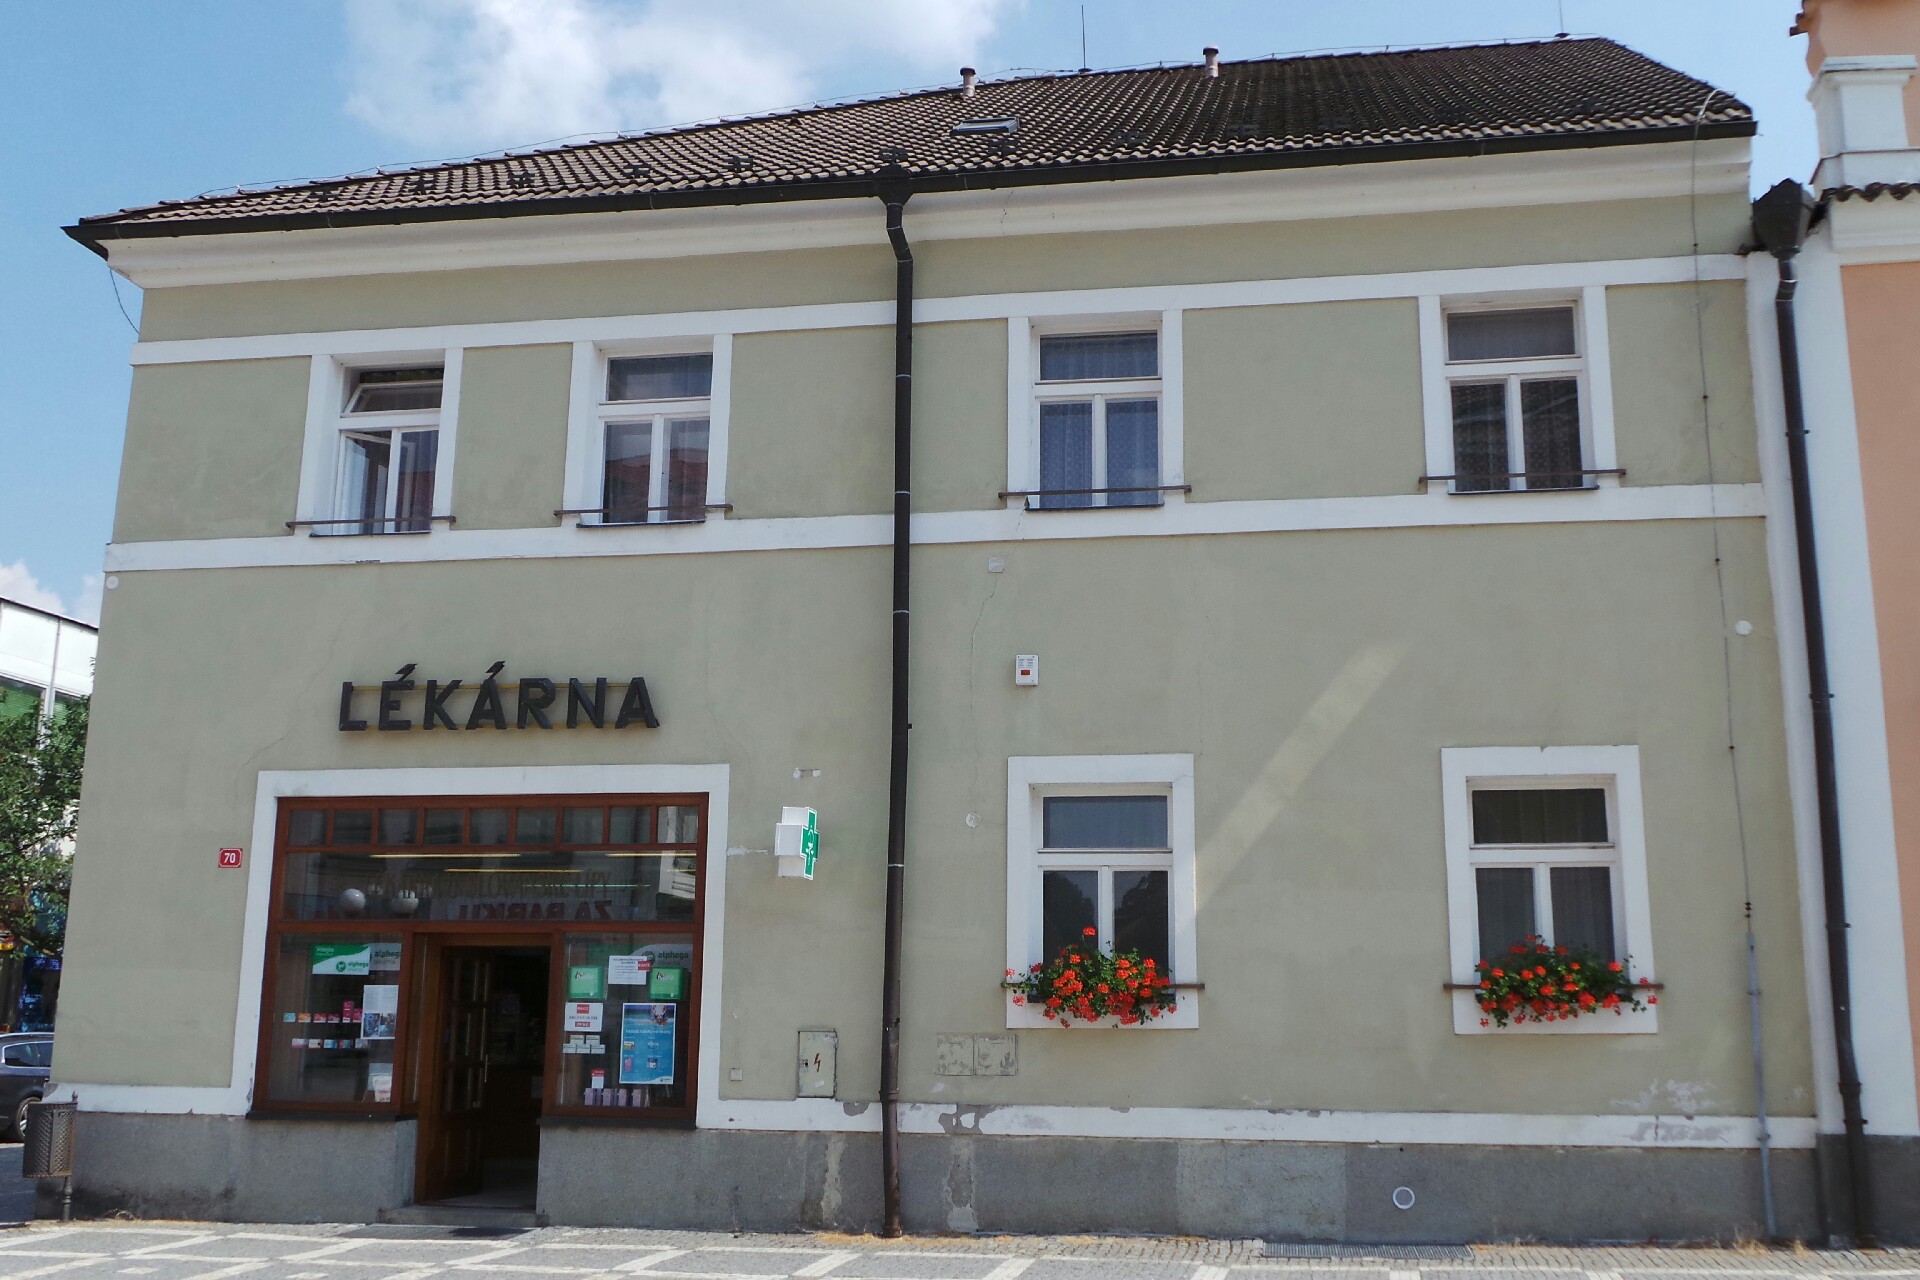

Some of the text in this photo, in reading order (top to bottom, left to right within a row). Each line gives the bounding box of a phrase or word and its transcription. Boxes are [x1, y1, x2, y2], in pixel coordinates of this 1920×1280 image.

[339, 661, 660, 731] LÉKÁRNA
[224, 852, 236, 864] 70
[374, 949, 401, 959] alpheg
